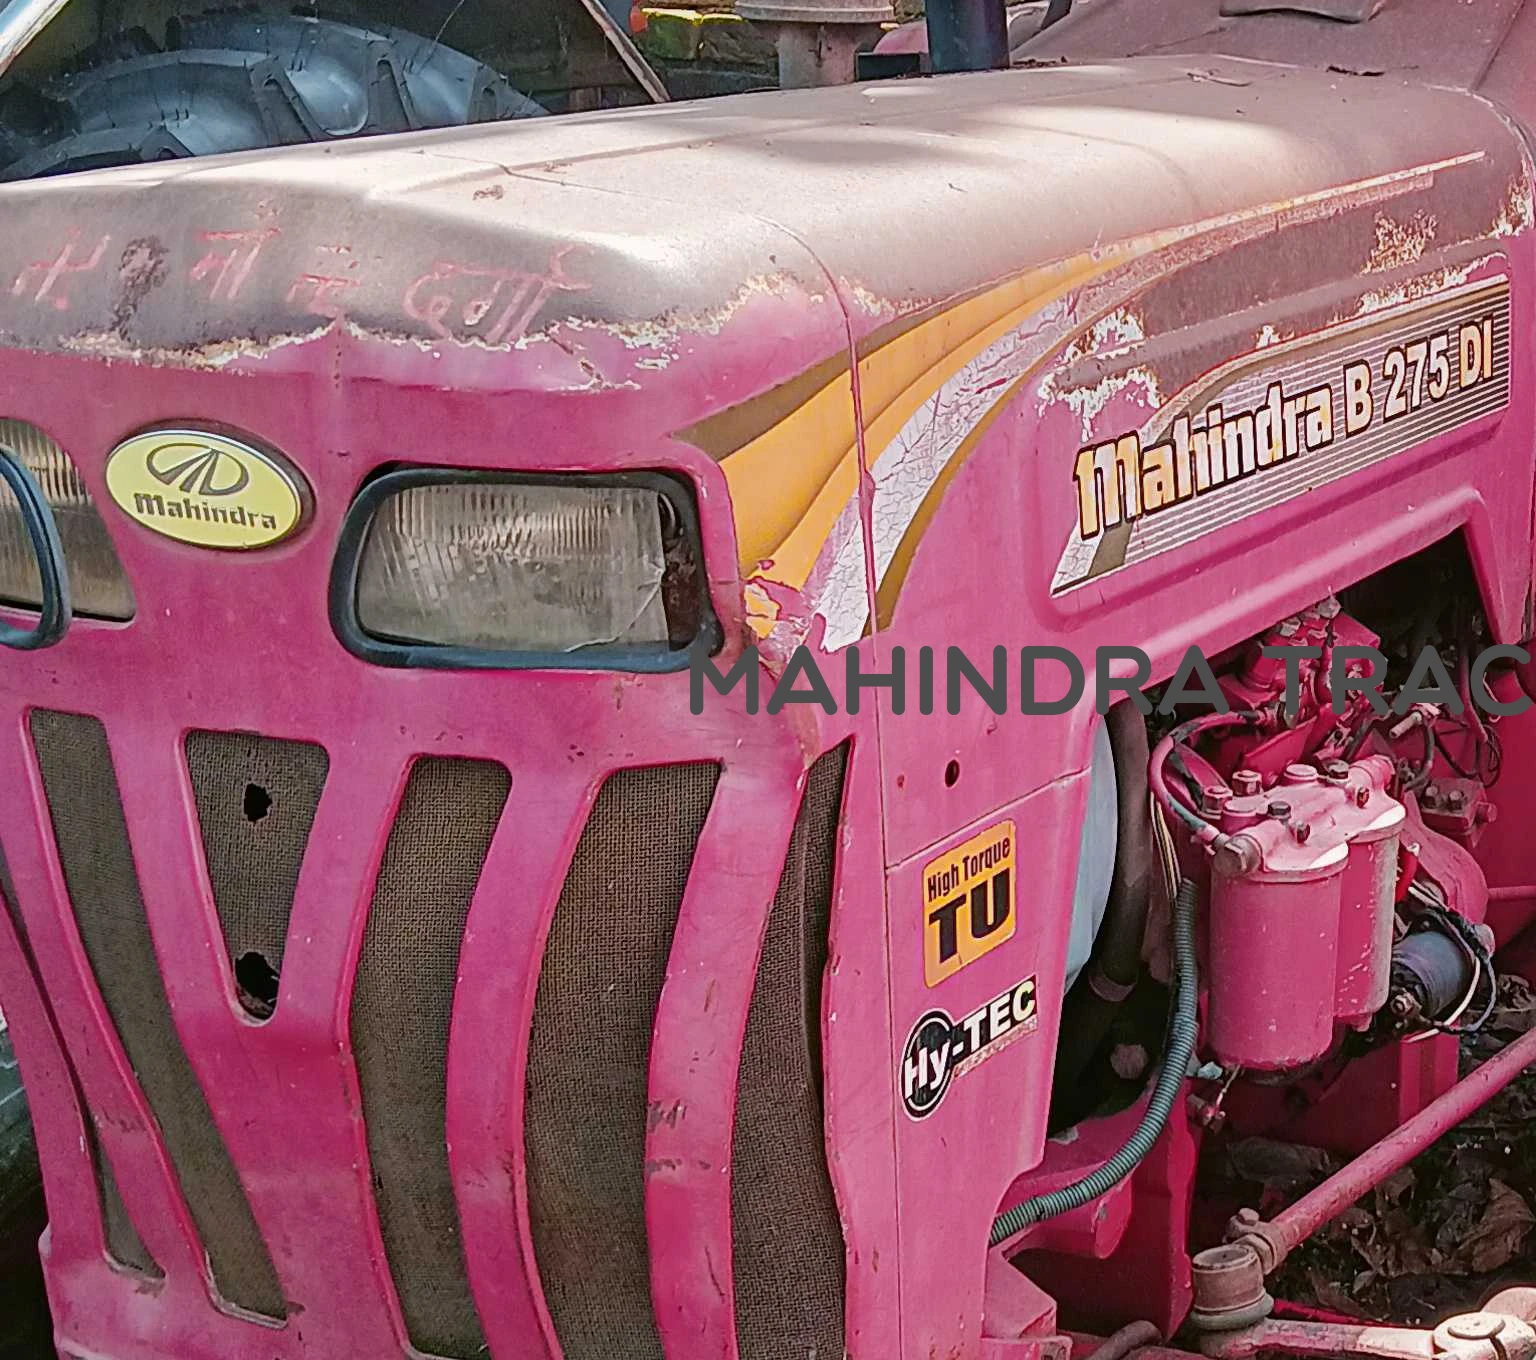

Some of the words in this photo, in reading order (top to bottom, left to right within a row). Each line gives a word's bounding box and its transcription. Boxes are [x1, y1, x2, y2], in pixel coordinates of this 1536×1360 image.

[1073, 381, 1334, 540] Mahindra
[1344, 358, 1374, 439] B
[1383, 332, 1451, 424] 275
[1458, 313, 1496, 391] DI
[133, 492, 278, 530] Mahindra
[927, 864, 960, 903] High
[962, 837, 1011, 883] Torque
[929, 866, 1011, 965] TU
[904, 979, 1036, 1101] Hy-TEC
